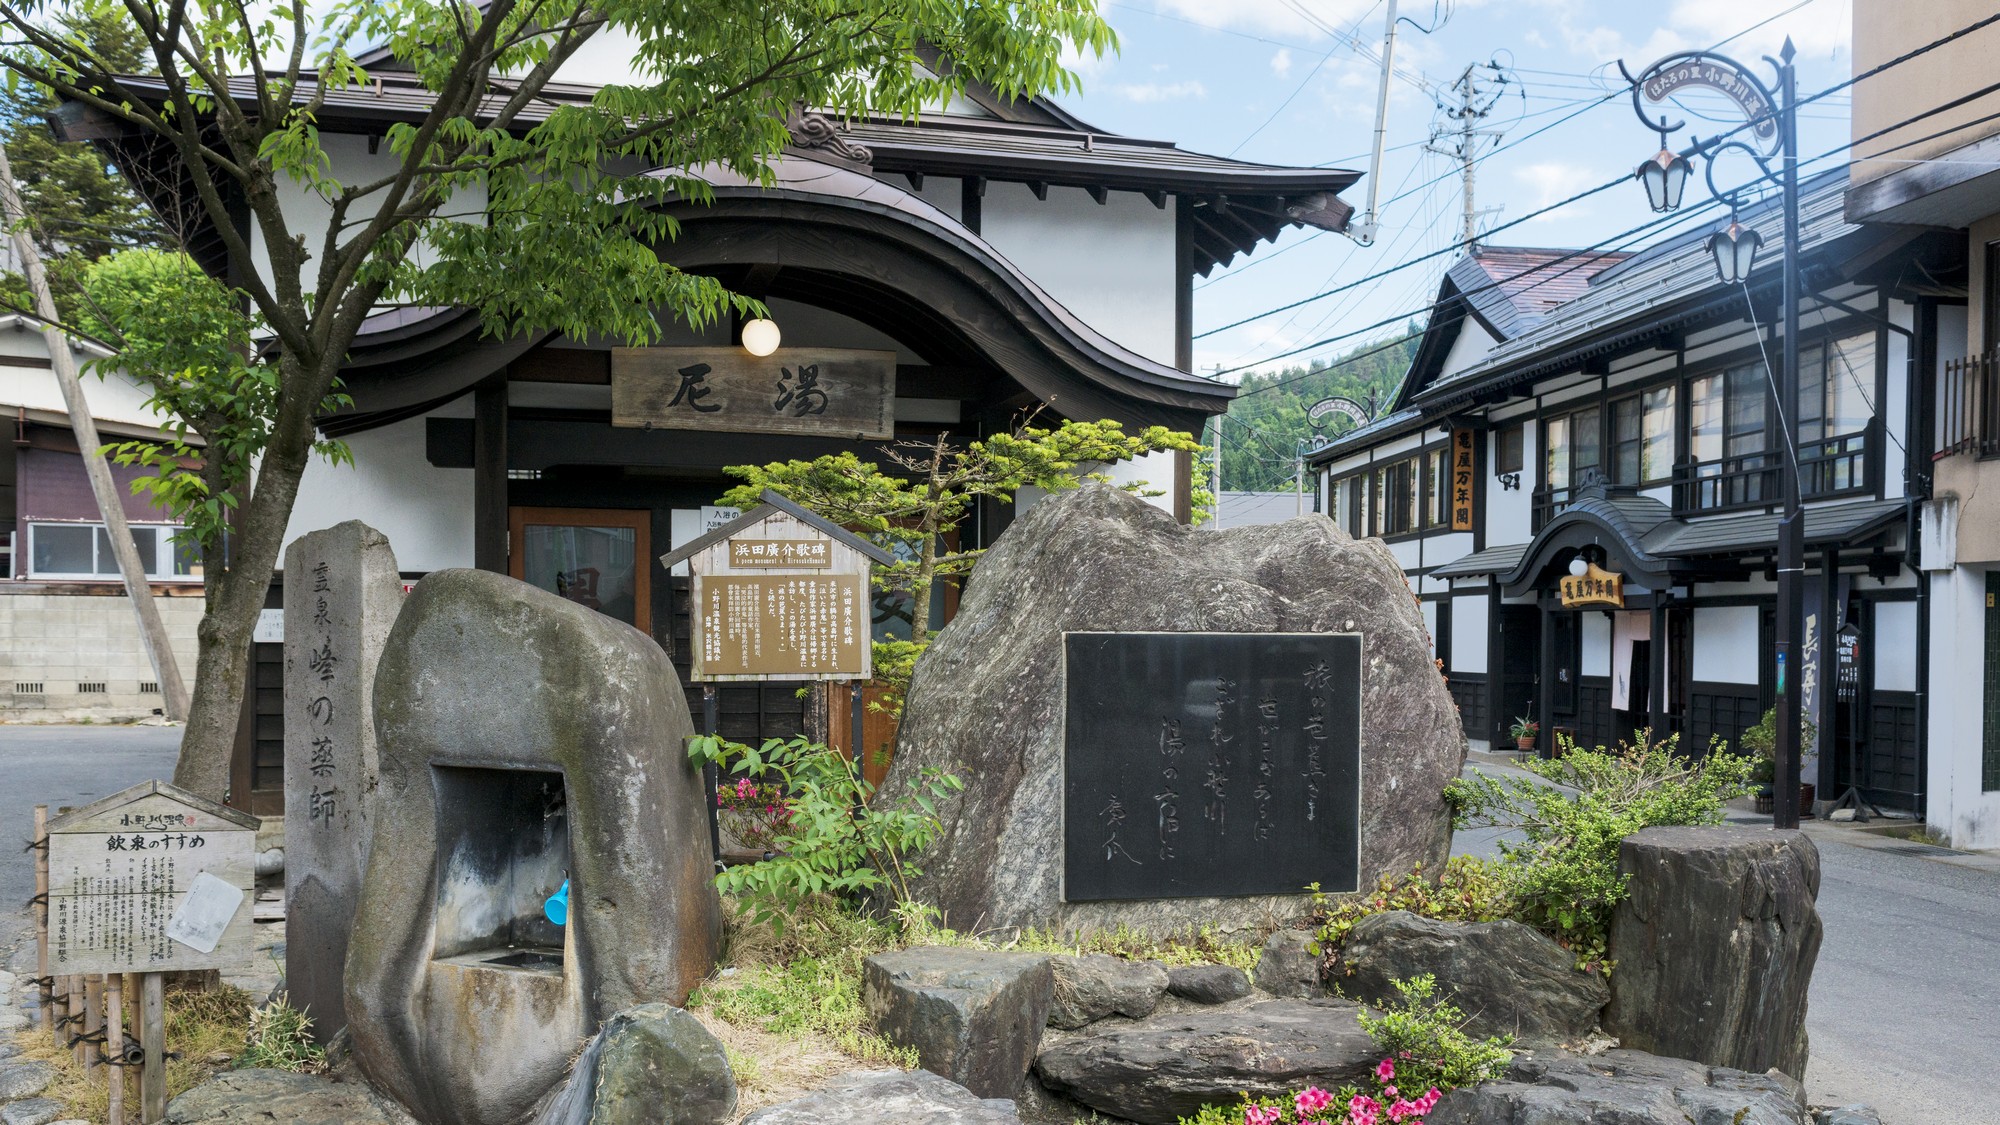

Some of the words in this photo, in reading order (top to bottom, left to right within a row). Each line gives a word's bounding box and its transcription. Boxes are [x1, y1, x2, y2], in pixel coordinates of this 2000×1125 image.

[1650, 66, 1702, 97] ほたるの里
[734, 542, 826, 558] 浜田廣介歌碑
[106, 833, 205, 852] 飲泉のすすめ
